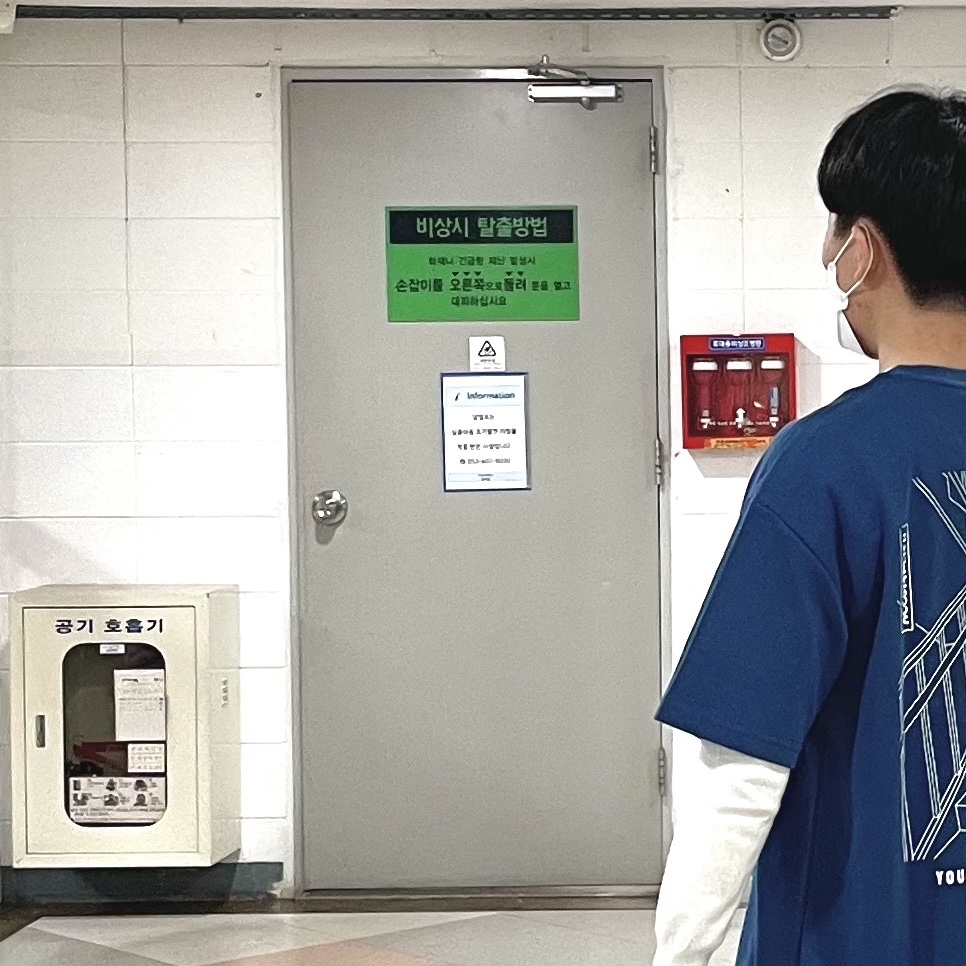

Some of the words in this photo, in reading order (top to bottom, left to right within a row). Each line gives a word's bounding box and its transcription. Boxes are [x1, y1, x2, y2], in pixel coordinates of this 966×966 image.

[416, 217, 468, 238] 비상시
[477, 216, 547, 238] 탈출방법
[395, 278, 443, 293] 손잡이를
[466, 391, 515, 400] Information
[55, 618, 94, 634] 공기
[103, 618, 164, 634] 호흡기
[935, 869, 965, 886] YOU
